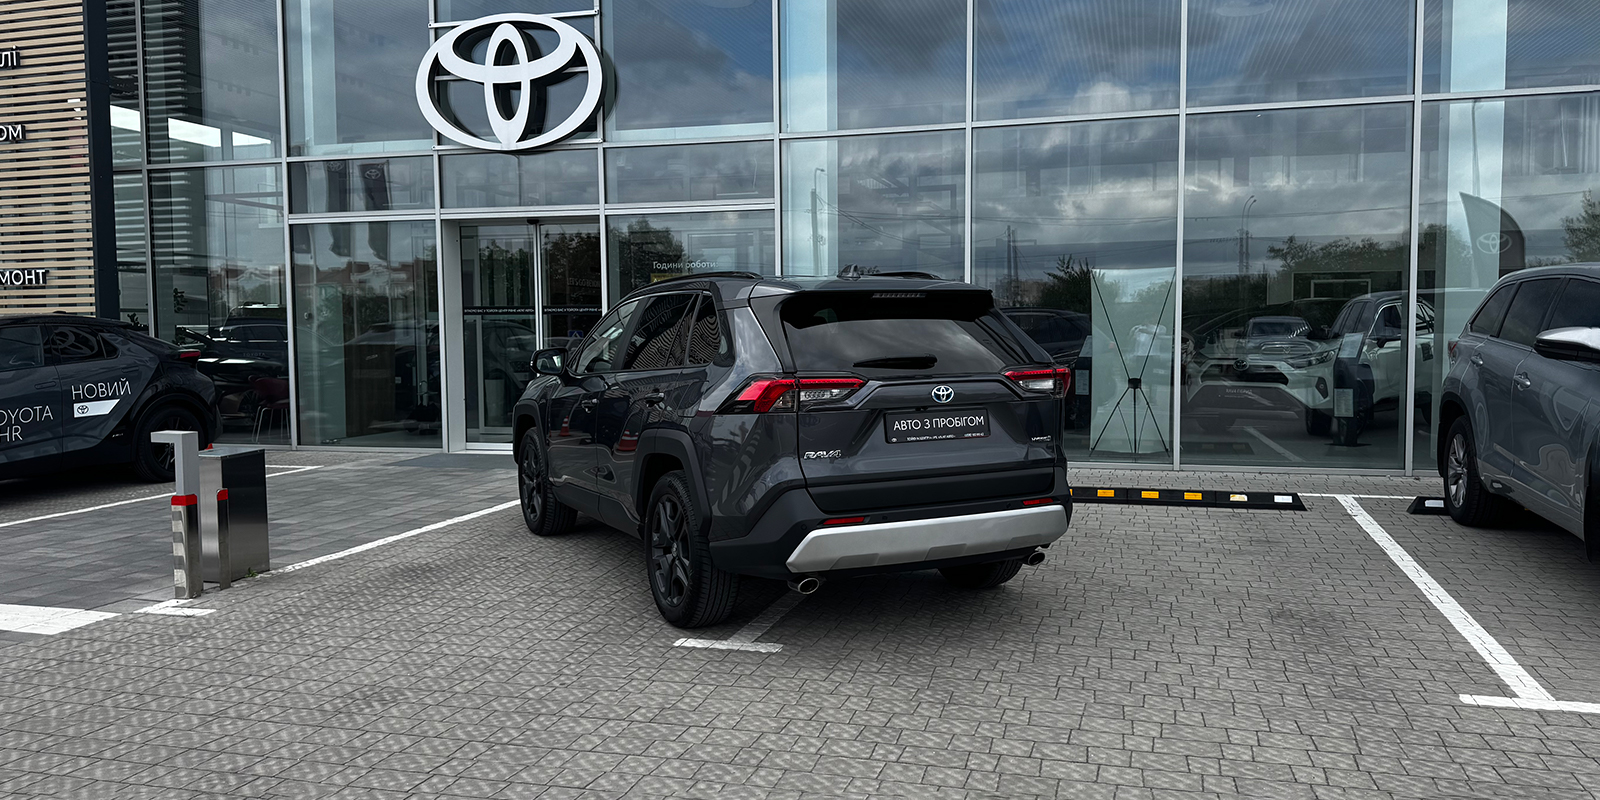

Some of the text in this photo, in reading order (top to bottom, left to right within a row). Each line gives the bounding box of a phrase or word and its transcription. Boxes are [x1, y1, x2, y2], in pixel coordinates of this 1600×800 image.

[652, 261, 683, 270] Години
[71, 377, 132, 400] НОВИЙ
[893, 419, 922, 431] АВТО
[932, 415, 985, 429] ПРОБІГОМ
[803, 449, 842, 460] RAV4
